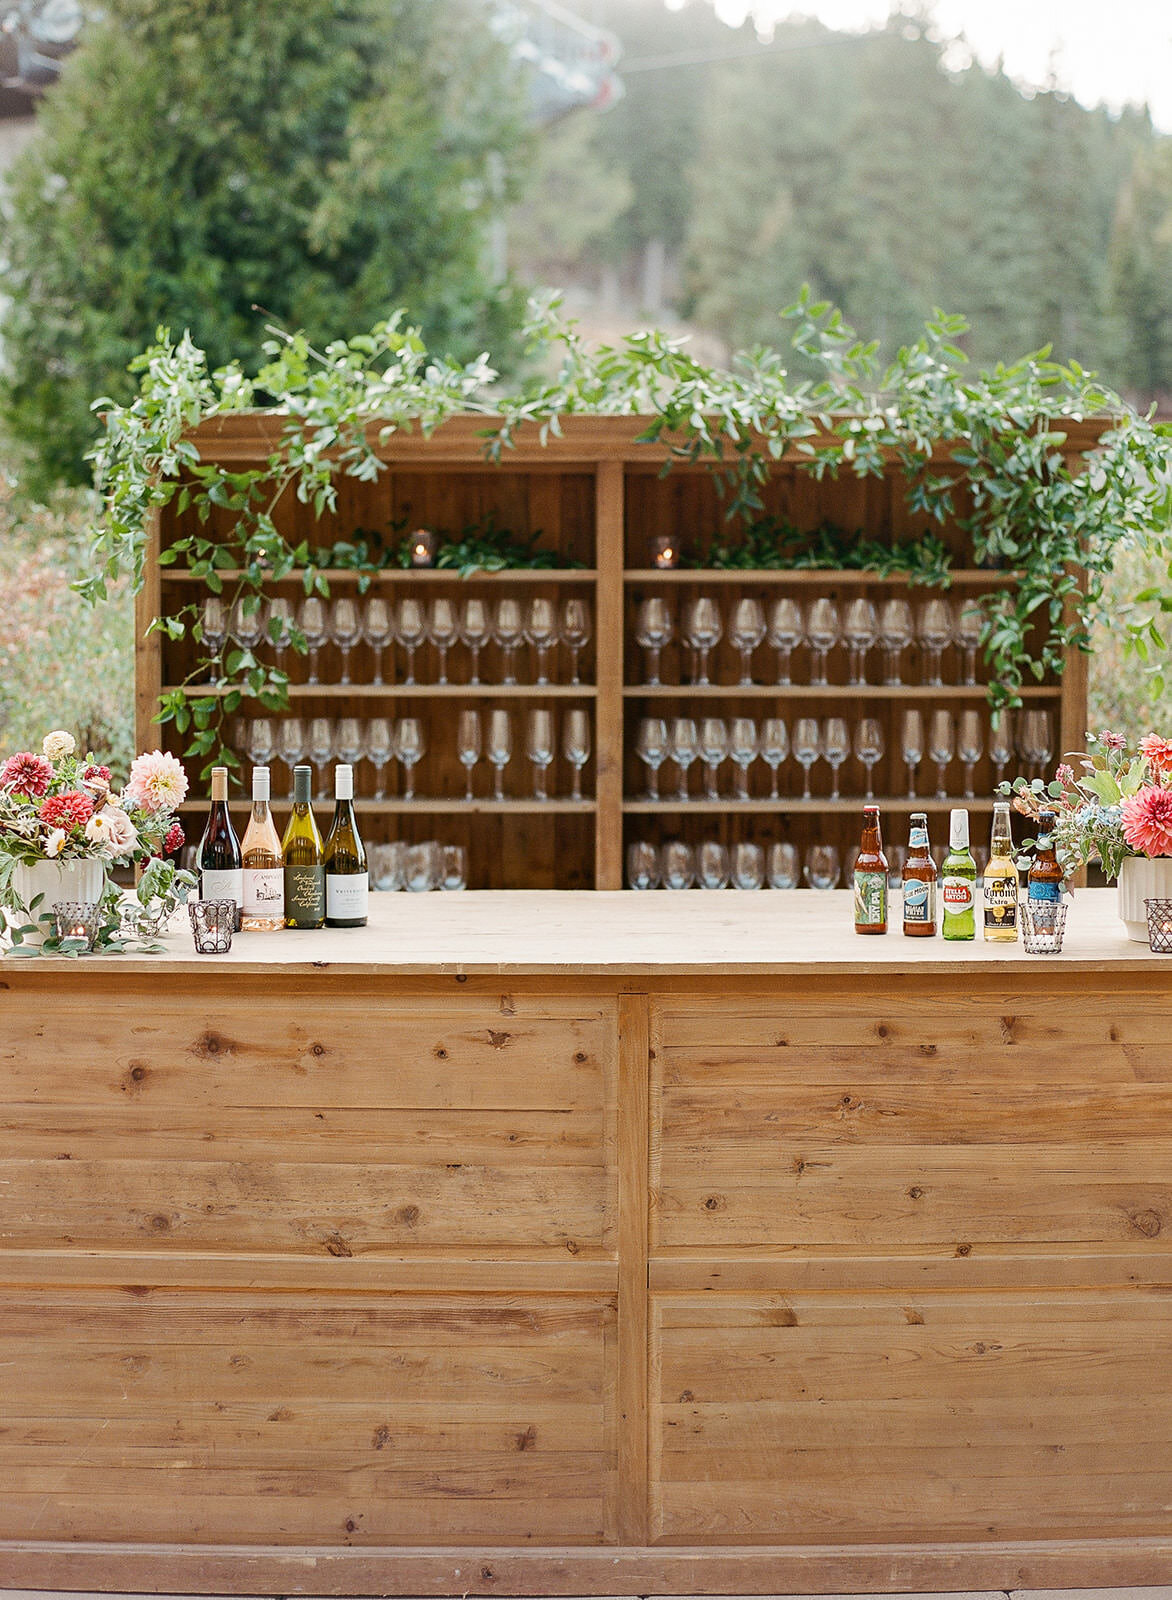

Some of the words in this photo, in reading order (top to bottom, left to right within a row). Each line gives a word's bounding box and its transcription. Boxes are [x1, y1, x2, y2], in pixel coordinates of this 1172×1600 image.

[914, 886, 929, 895] MOON
[945, 887, 967, 895] STELLA
[984, 887, 1016, 898] Corona
